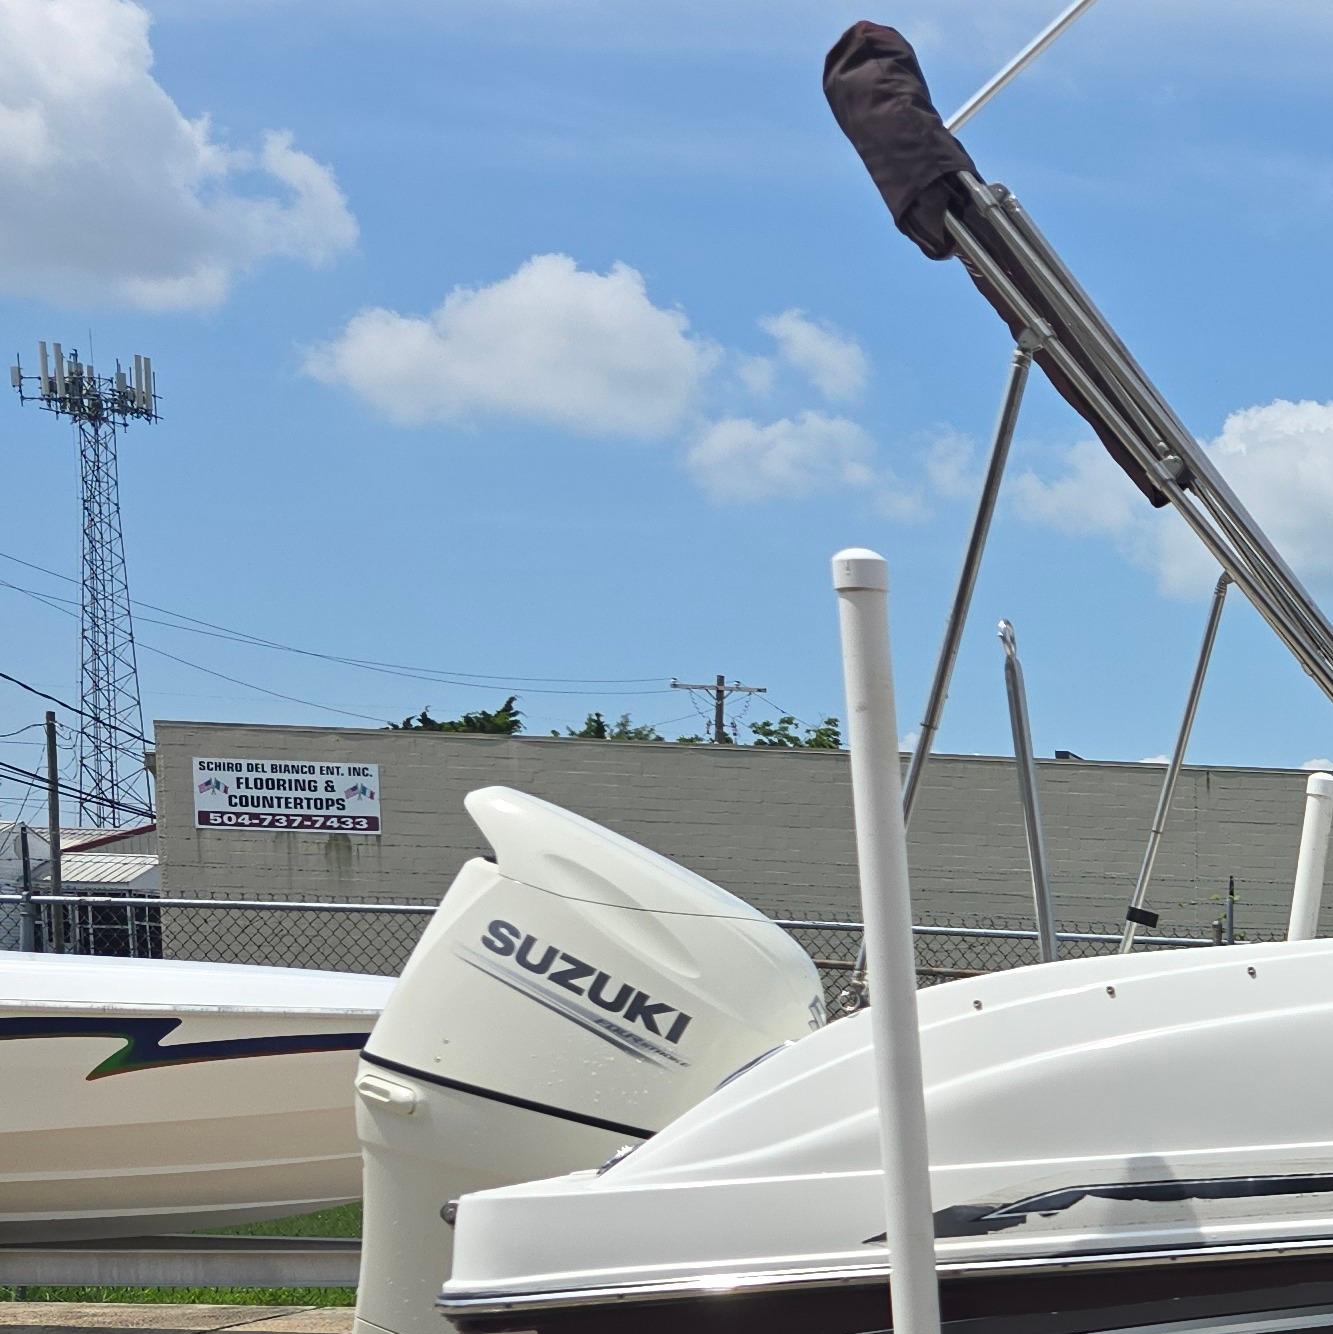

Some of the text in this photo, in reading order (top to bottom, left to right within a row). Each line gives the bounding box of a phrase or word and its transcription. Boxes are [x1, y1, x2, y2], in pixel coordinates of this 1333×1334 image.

[199, 761, 373, 777] SCHIRO DEL BIANCO ENT. INC.
[236, 777, 336, 793] FLOORING &
[228, 795, 346, 811] COUNTERTOPS
[209, 813, 368, 829] 504-737-7433
[481, 919, 693, 1044] SUZUKI
